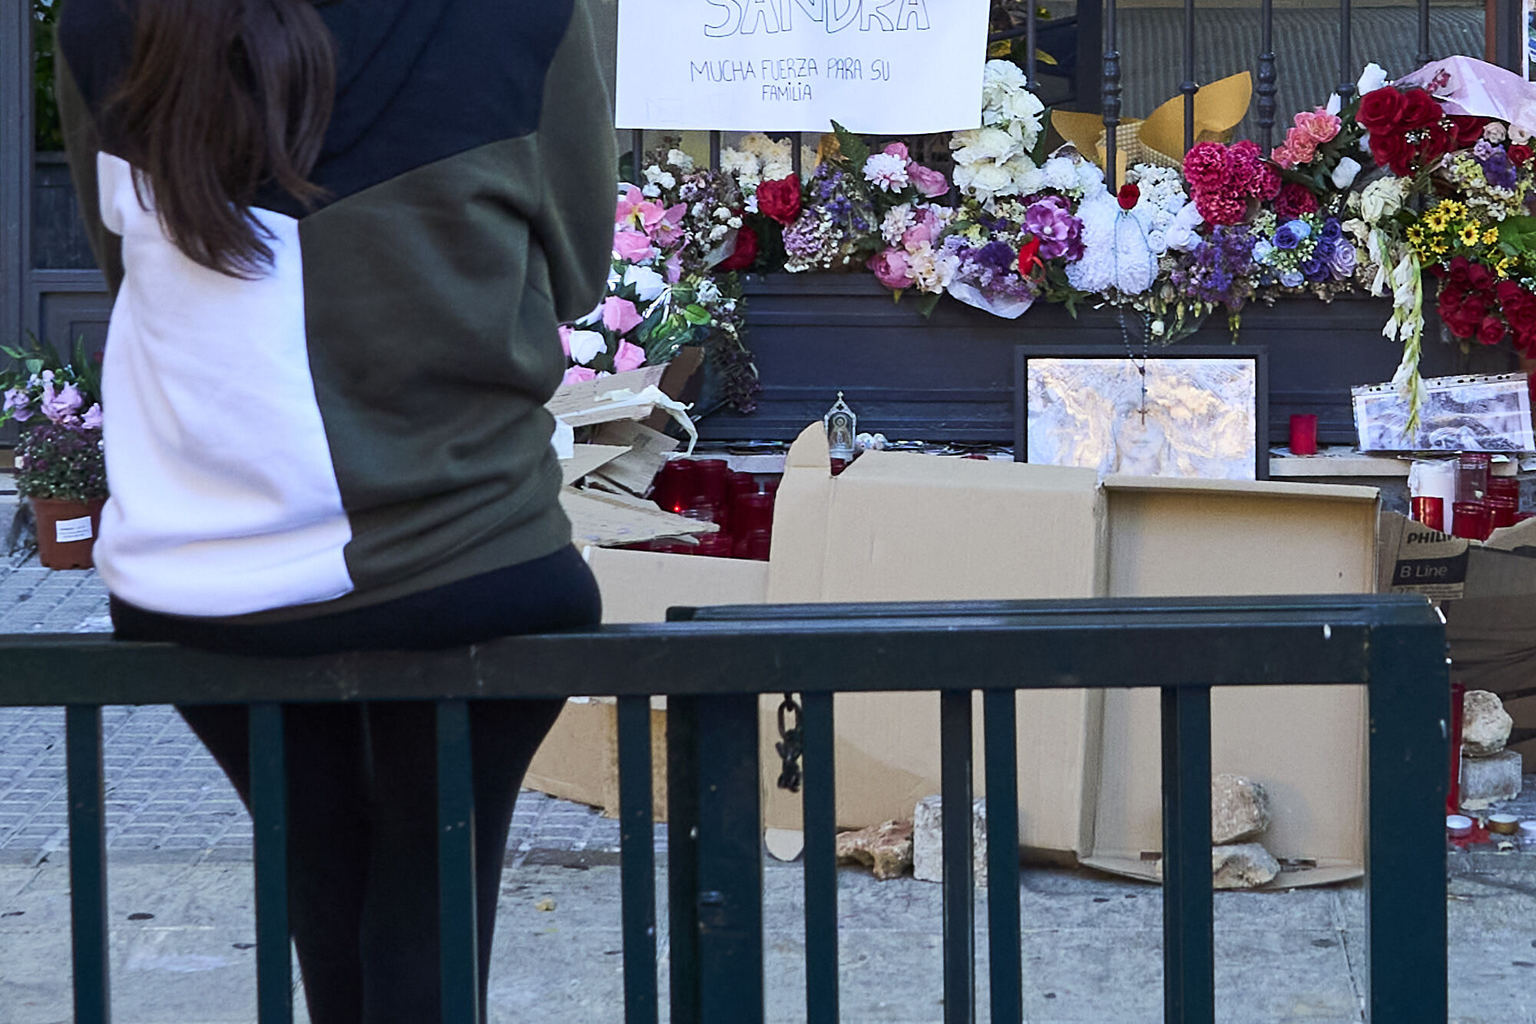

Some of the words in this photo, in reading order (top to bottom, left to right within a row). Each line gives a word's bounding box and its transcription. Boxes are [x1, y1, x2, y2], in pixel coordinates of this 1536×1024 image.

[690, 59, 755, 82] MUCHA
[761, 57, 818, 82] FUERZA
[827, 58, 862, 81] PARA
[870, 59, 891, 82] SU
[762, 81, 812, 102] FAMILIA
[1399, 565, 1412, 578] B
[1415, 564, 1449, 578] Line
